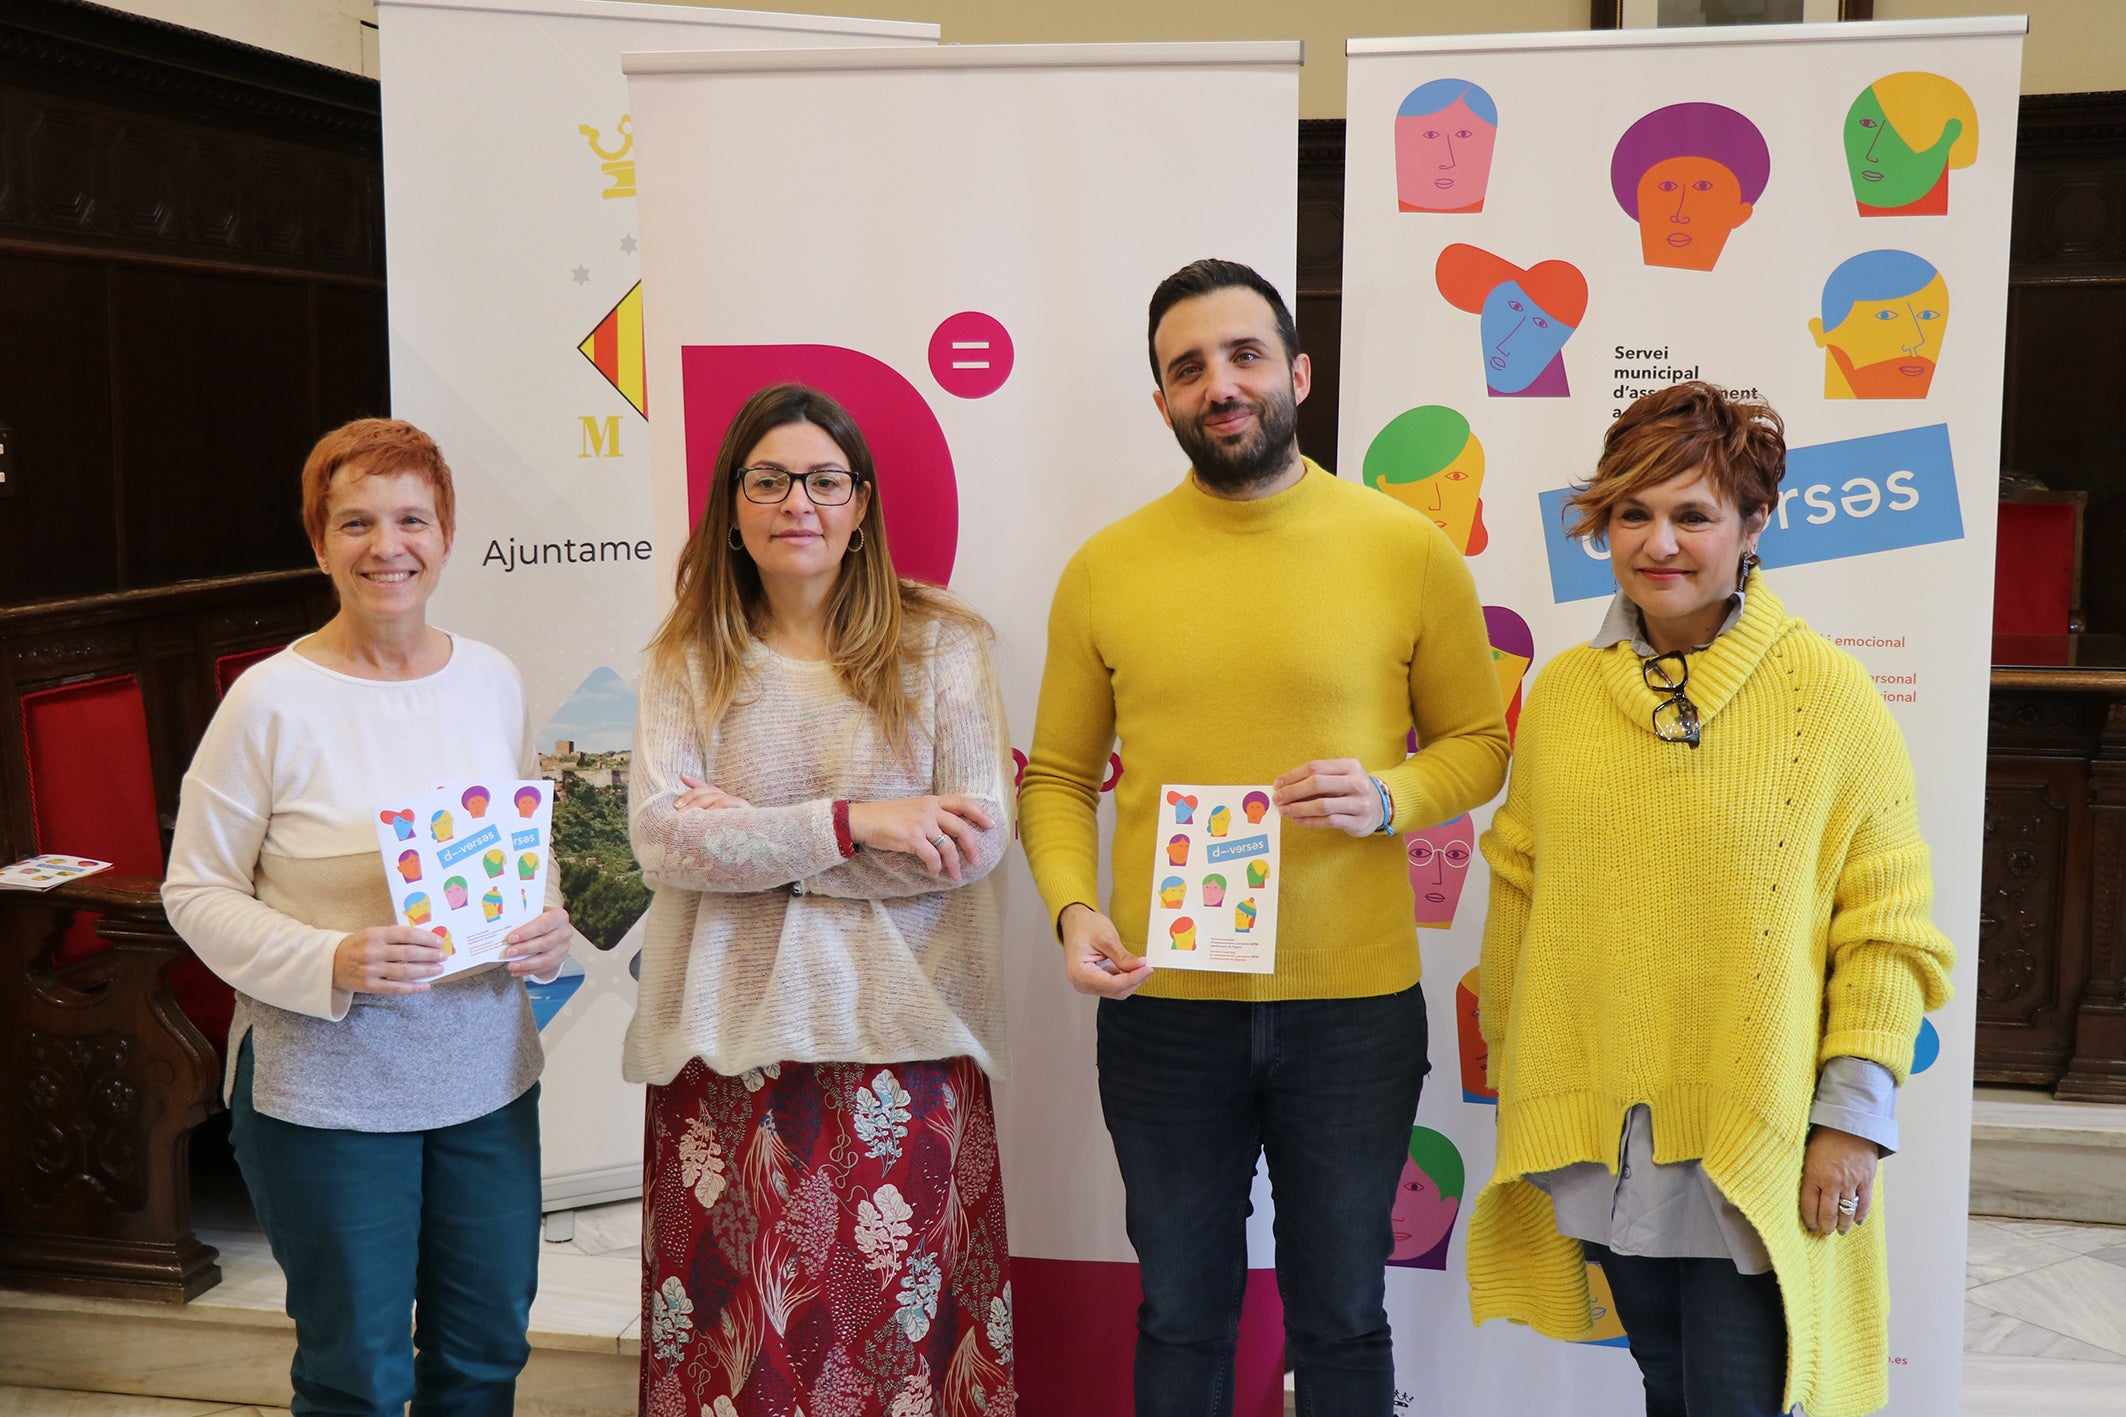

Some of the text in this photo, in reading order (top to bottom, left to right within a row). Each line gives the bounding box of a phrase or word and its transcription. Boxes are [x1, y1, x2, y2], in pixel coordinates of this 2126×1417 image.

[1614, 346, 1669, 360] Servei
[1613, 365, 1699, 383] municipal
[577, 415, 625, 458] M
[482, 537, 653, 573] Ajuntame
[1834, 636, 1905, 648] emocional
[1870, 673, 1917, 684] rsonal
[1882, 691, 1917, 702] ional
